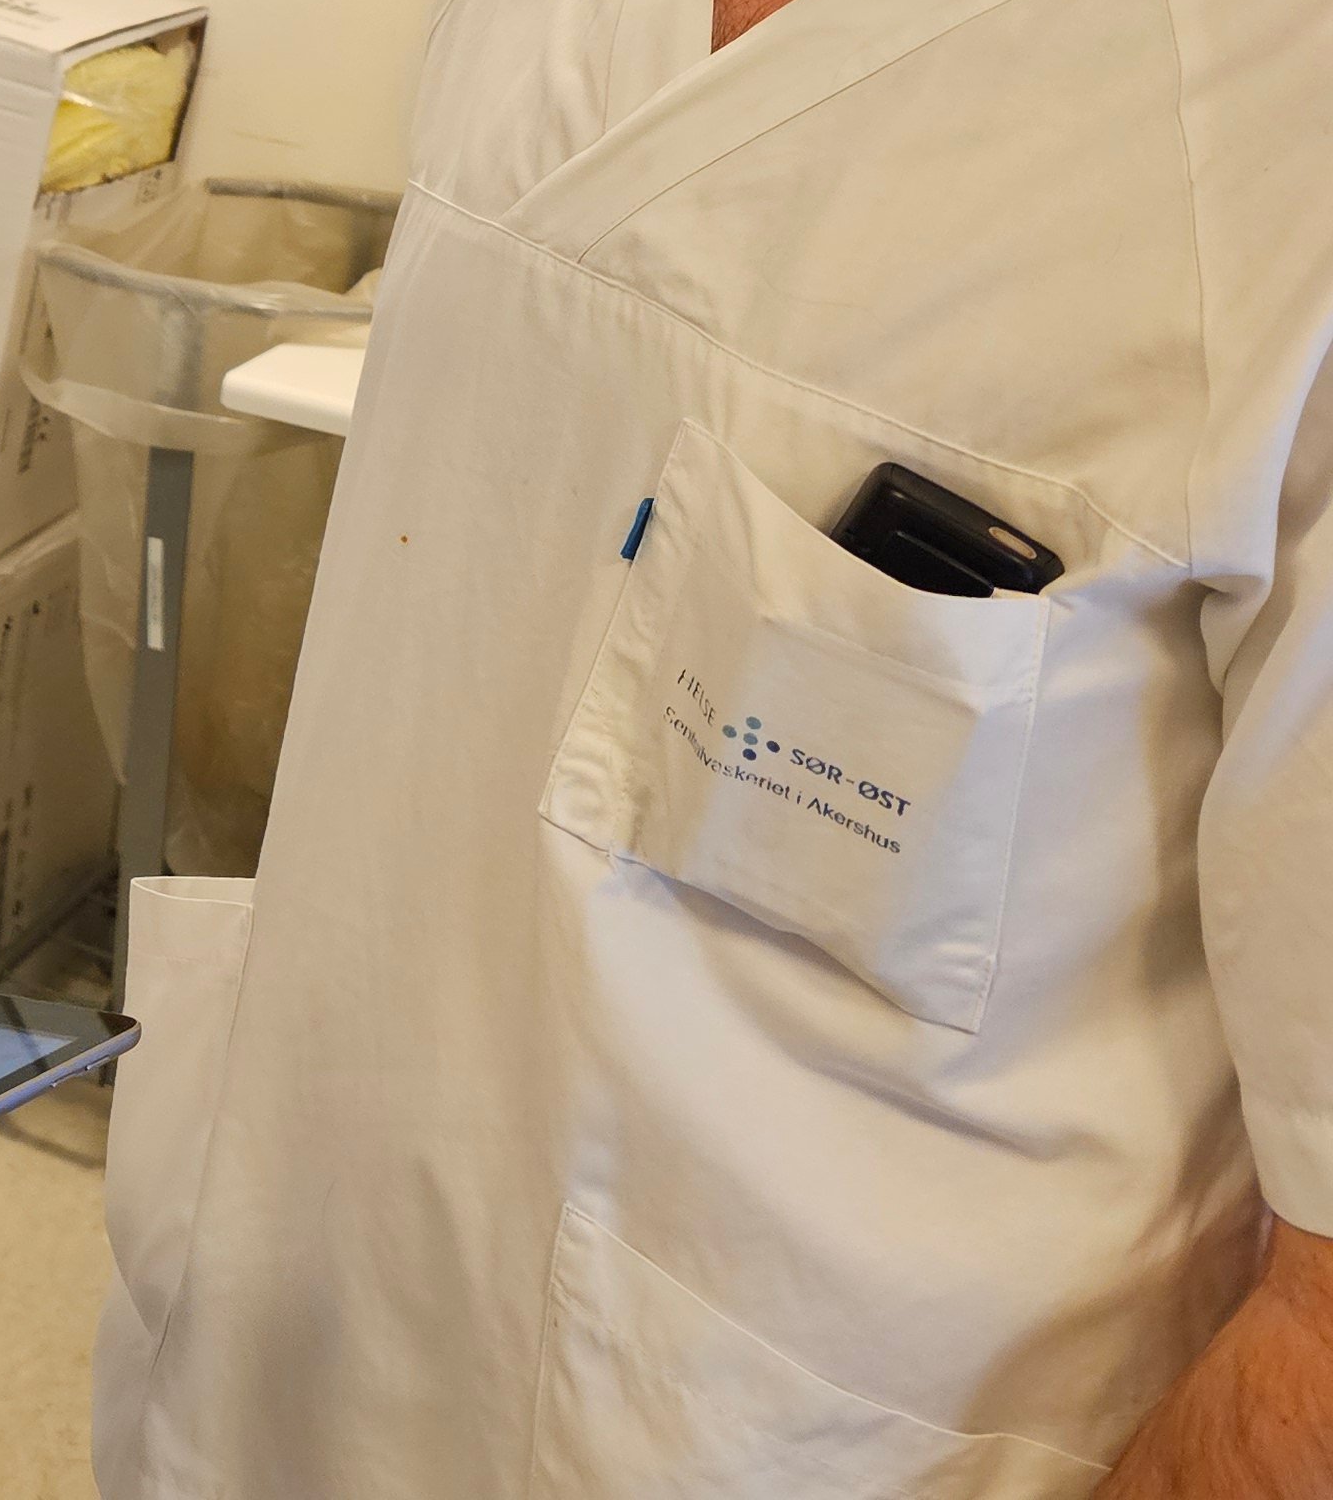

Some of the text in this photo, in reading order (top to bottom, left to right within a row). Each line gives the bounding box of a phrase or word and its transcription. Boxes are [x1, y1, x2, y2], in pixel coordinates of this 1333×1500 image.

[677, 668, 717, 728] HELSE
[795, 790, 803, 805] i
[806, 798, 902, 855] Akershus
